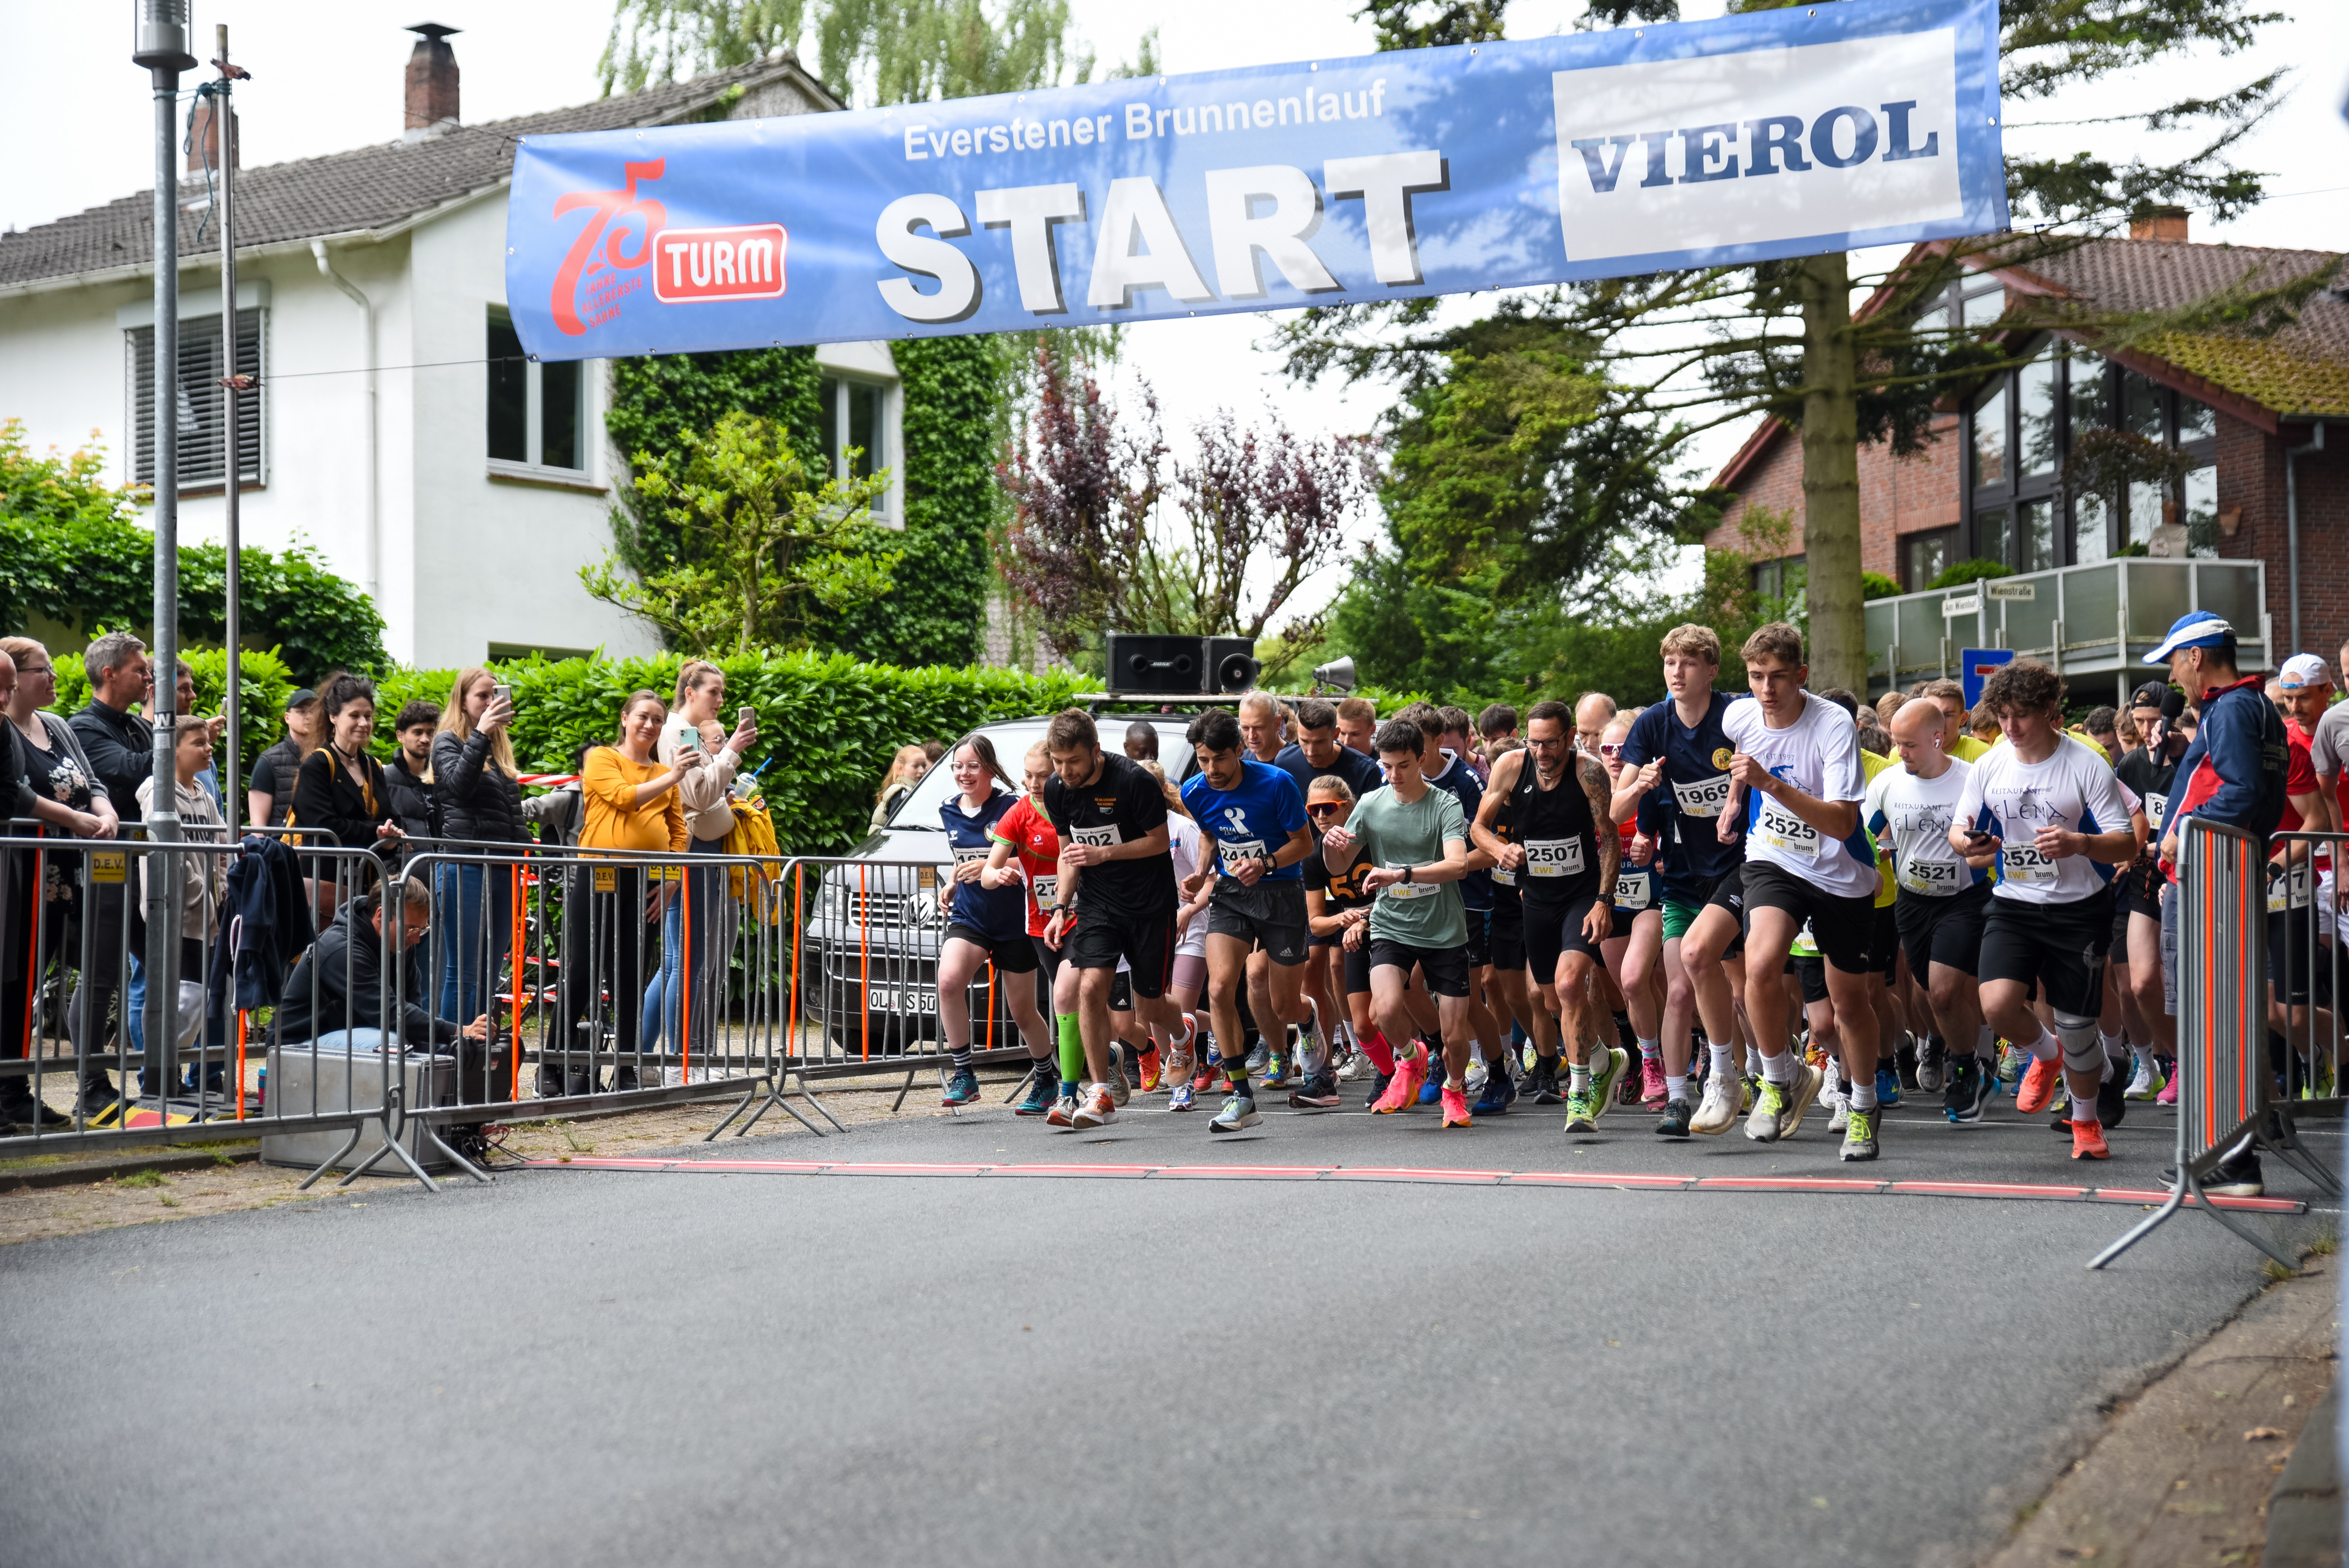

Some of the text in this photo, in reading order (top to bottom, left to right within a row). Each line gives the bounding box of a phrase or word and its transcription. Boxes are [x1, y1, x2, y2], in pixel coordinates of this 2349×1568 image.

[904, 79, 1386, 161] Everstener Brunnenlauf
[1571, 99, 1939, 193] VIEROL
[876, 149, 1447, 322] START
[665, 238, 774, 288] TURM
[582, 275, 643, 314] ALLERERSTE
[589, 303, 622, 329] SAHNE
[1990, 585, 2031, 596] Wienstraße
[1700, 778, 1726, 788] Brunnenlauf
[1678, 783, 1730, 804] 1969
[1894, 802, 1942, 811] RESTAURANT
[1764, 812, 1817, 839] 2525
[1076, 833, 1113, 847] 902
[1766, 835, 1786, 847] EWE
[1794, 842, 1814, 852] bruns
[1527, 843, 1579, 862] 2507
[93, 859, 123, 869] D.E.V.
[1562, 864, 1580, 872] bruns
[1908, 862, 1955, 880] 2521
[596, 872, 614, 881] D.E.V.
[1493, 873, 1506, 882] EWE
[2008, 871, 2027, 879] EWE
[1615, 881, 1641, 895] 87
[1911, 879, 1929, 889] EWE
